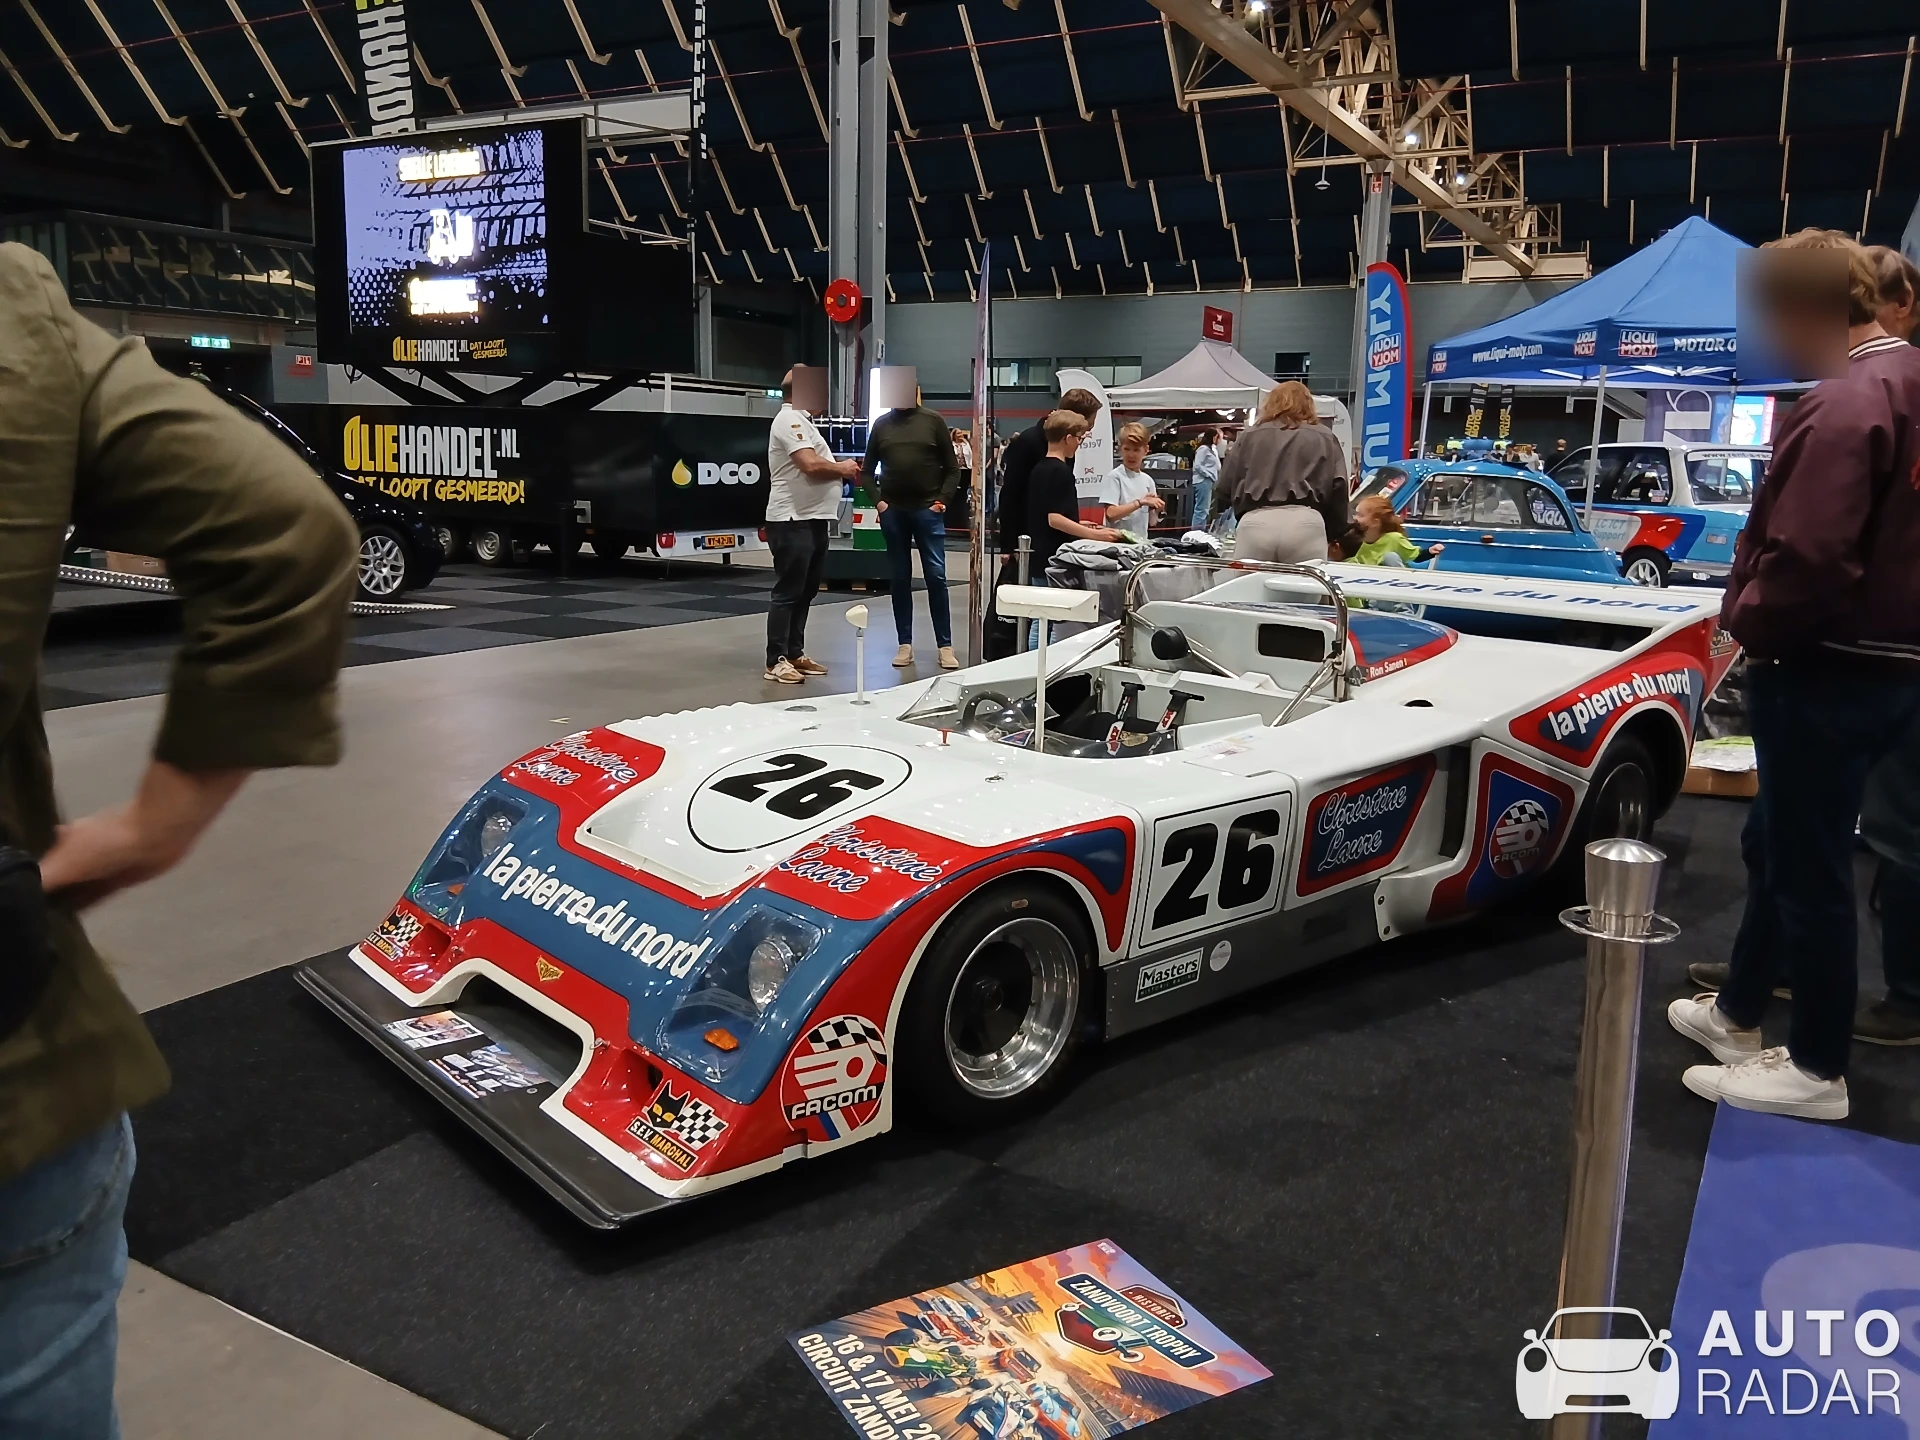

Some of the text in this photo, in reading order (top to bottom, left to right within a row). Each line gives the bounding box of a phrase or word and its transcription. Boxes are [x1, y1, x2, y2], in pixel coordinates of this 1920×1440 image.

[483, 339, 505, 349] LOOPT
[1574, 344, 1596, 357] MOLY
[1578, 331, 1597, 344] LIQUI
[1620, 344, 1657, 356] MOLY
[1622, 331, 1656, 344] LIQUI
[1673, 337, 1725, 352] MOTOR
[697, 462, 760, 485] DCO
[380, 477, 432, 501] LOOPT
[435, 479, 525, 505] GESMEERD!
[1493, 590, 1555, 600] du
[1560, 597, 1700, 613] nord
[1370, 665, 1384, 679] Ron
[1548, 667, 1691, 741] la pierre du nord
[543, 730, 638, 784] Christine
[709, 753, 884, 820] 26
[1318, 785, 1407, 836] Christine
[814, 824, 942, 882] Christine
[1317, 827, 1383, 873] Laure
[1493, 847, 1540, 864] FACOM
[776, 847, 869, 893] Laure
[1151, 809, 1281, 931] 26
[482, 842, 514, 887] la
[501, 864, 597, 924] pierre
[585, 899, 640, 946] du
[620, 921, 714, 979] nord
[1142, 960, 1198, 988] Masters
[791, 1084, 877, 1121] FACOM
[628, 1119, 691, 1168] S.E.V. MARCHAL
[1069, 1279, 1202, 1360] ZANDVOORT TROPHY
[1132, 1293, 1176, 1321] HISTORIC
[832, 1333, 864, 1355] 16
[797, 1332, 861, 1394] CIRCUIT
[847, 1354, 876, 1372] &
[860, 1369, 895, 1388] 17
[875, 1388, 922, 1425] MEI
